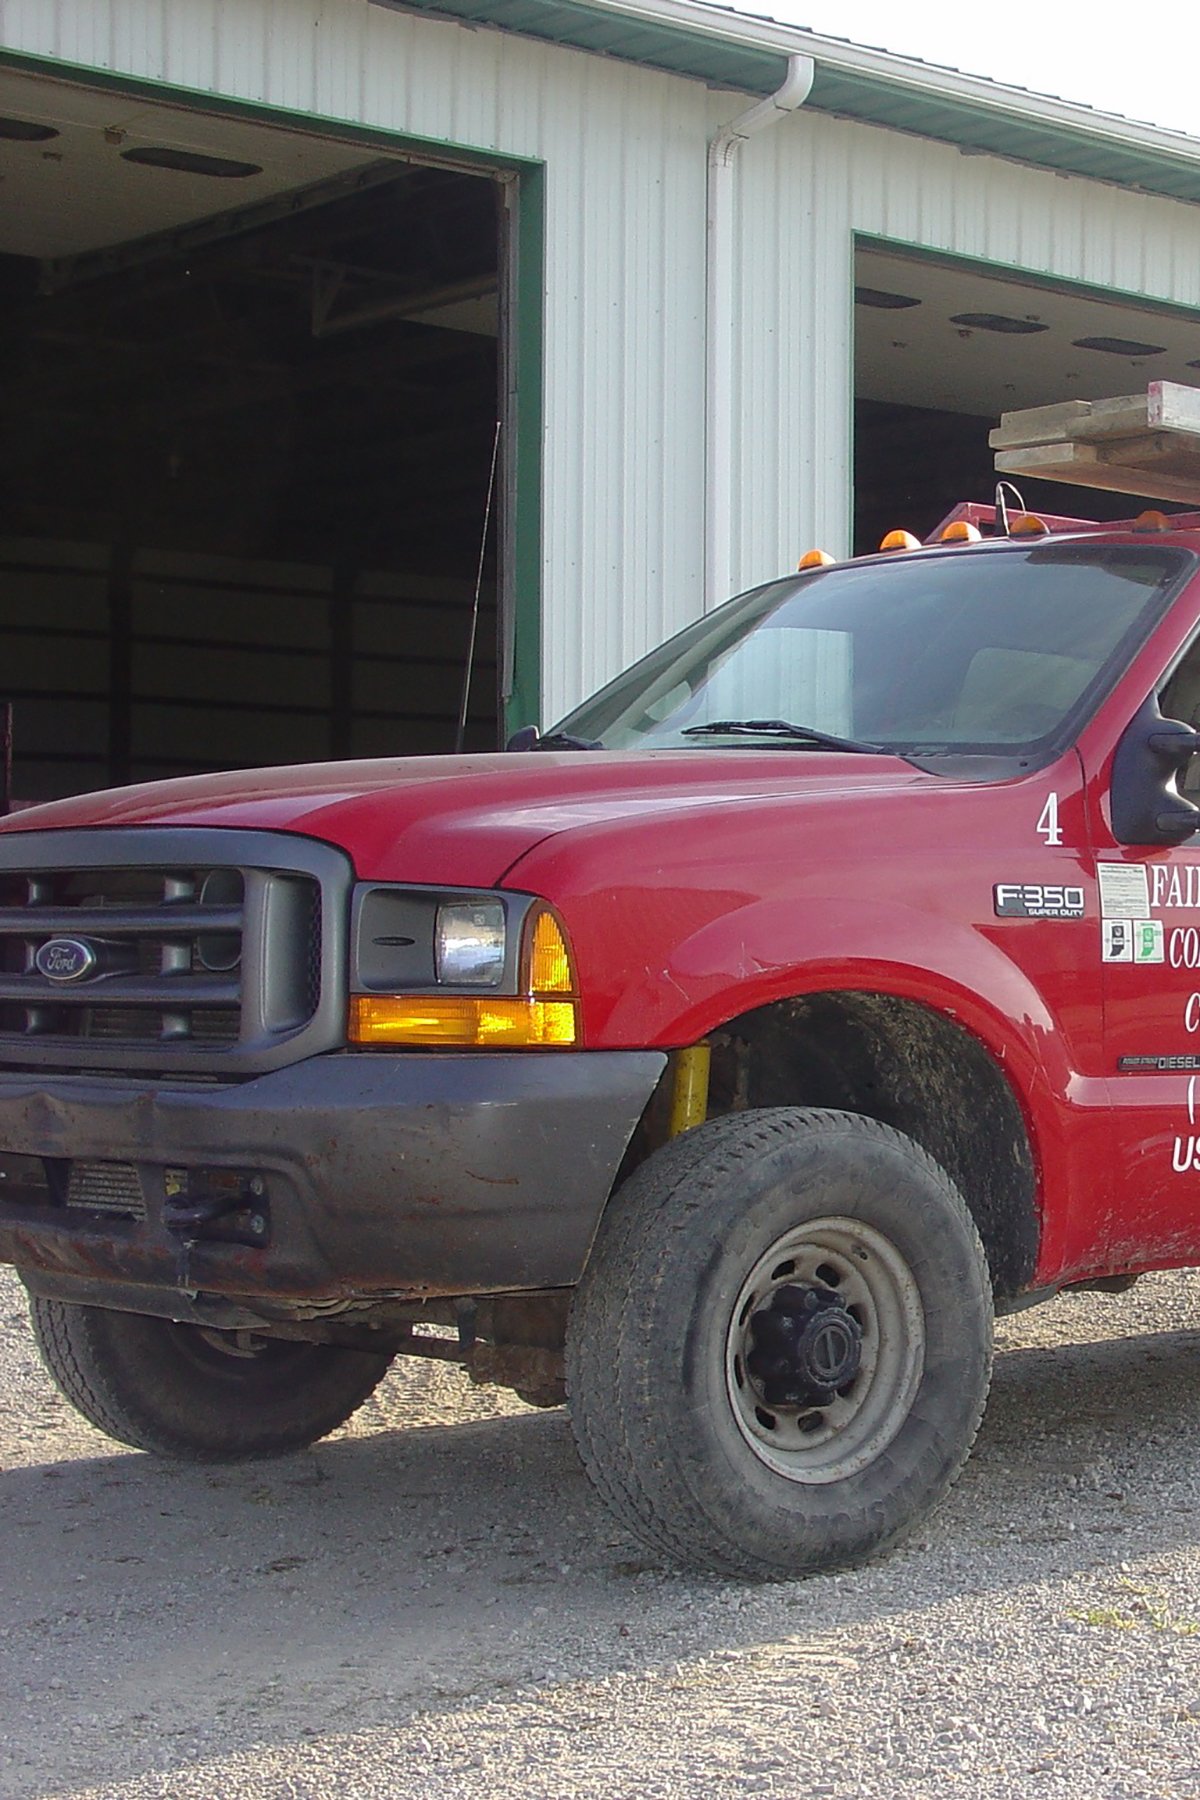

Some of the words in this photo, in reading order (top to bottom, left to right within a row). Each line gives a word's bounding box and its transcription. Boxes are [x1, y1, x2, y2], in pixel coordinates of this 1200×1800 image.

[1036, 793, 1063, 846] 4
[1028, 908, 1058, 916] SUPER
[1060, 909, 1084, 917] DUTY
[46, 946, 77, 971] Ford
